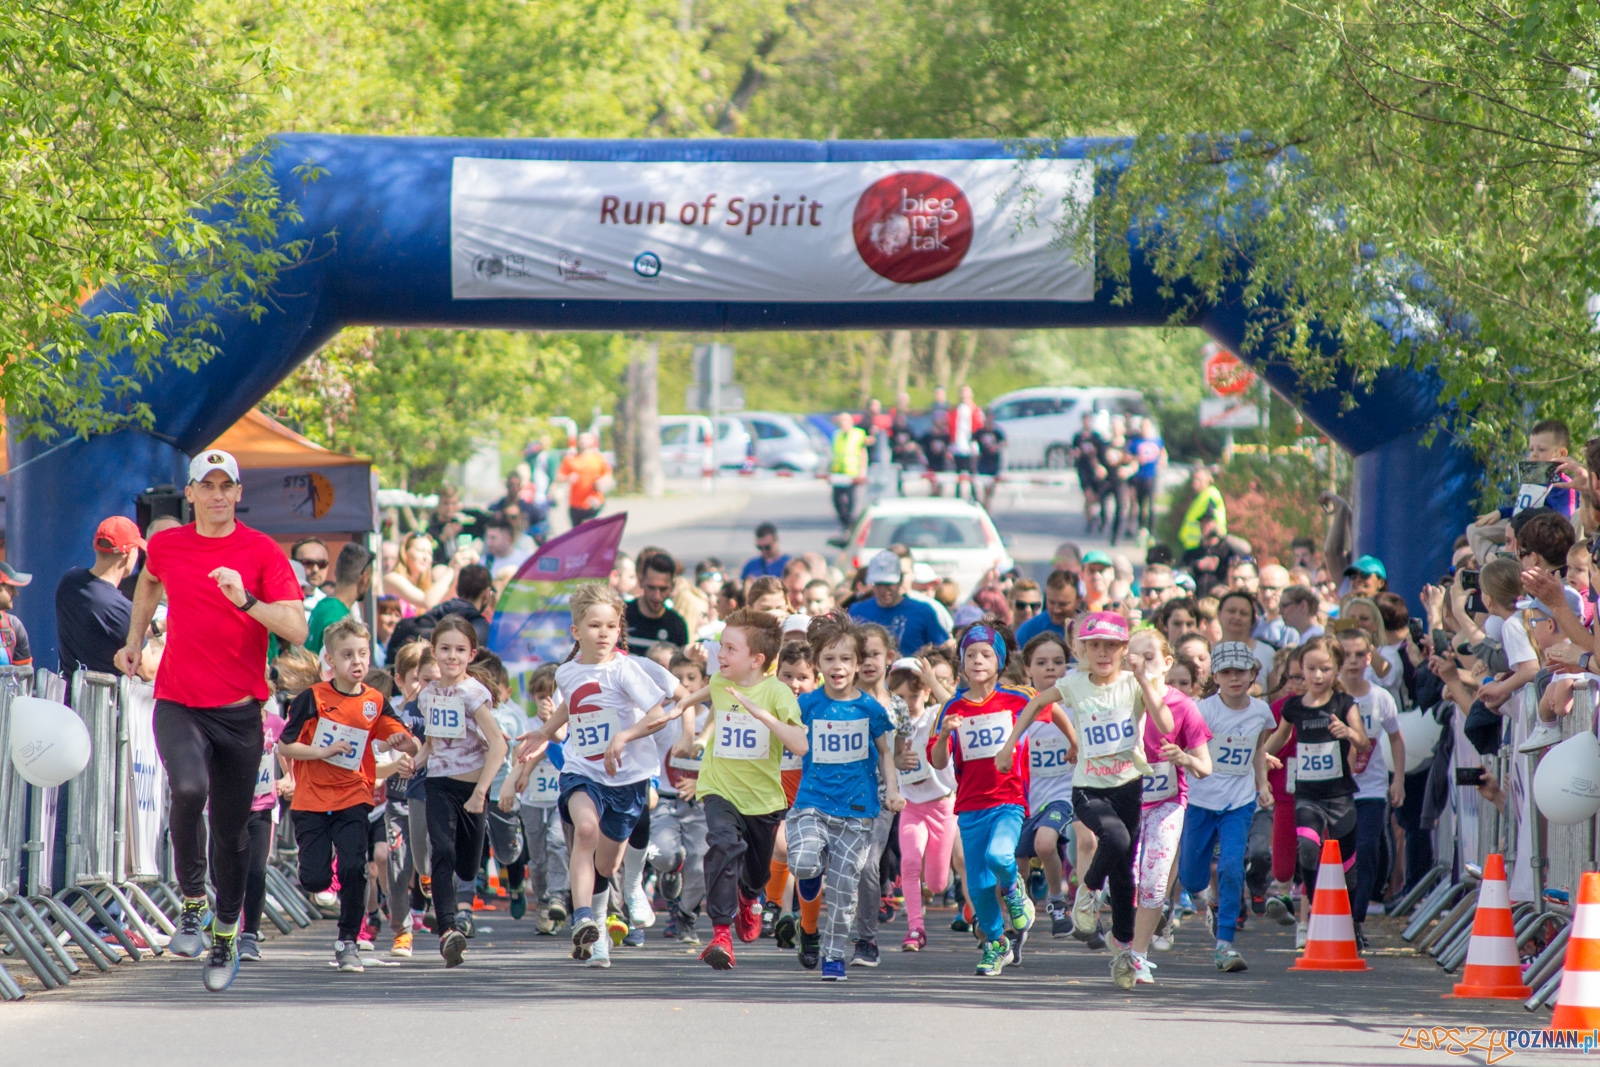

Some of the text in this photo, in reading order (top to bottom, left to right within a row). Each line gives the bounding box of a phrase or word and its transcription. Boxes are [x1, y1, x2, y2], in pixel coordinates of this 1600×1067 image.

[600, 193, 824, 236] Run of Spirit
[901, 187, 959, 225] bieg
[911, 215, 939, 230] na
[911, 229, 950, 250] tak
[283, 474, 308, 488] STS
[429, 707, 459, 727] 1813
[576, 722, 610, 747] 337
[721, 726, 757, 749] 316
[818, 732, 863, 752] 1810
[965, 725, 1006, 749] 282
[1084, 718, 1135, 746] 1806
[1030, 748, 1068, 768] 320
[1217, 746, 1252, 766] 257
[1301, 754, 1334, 771] 269
